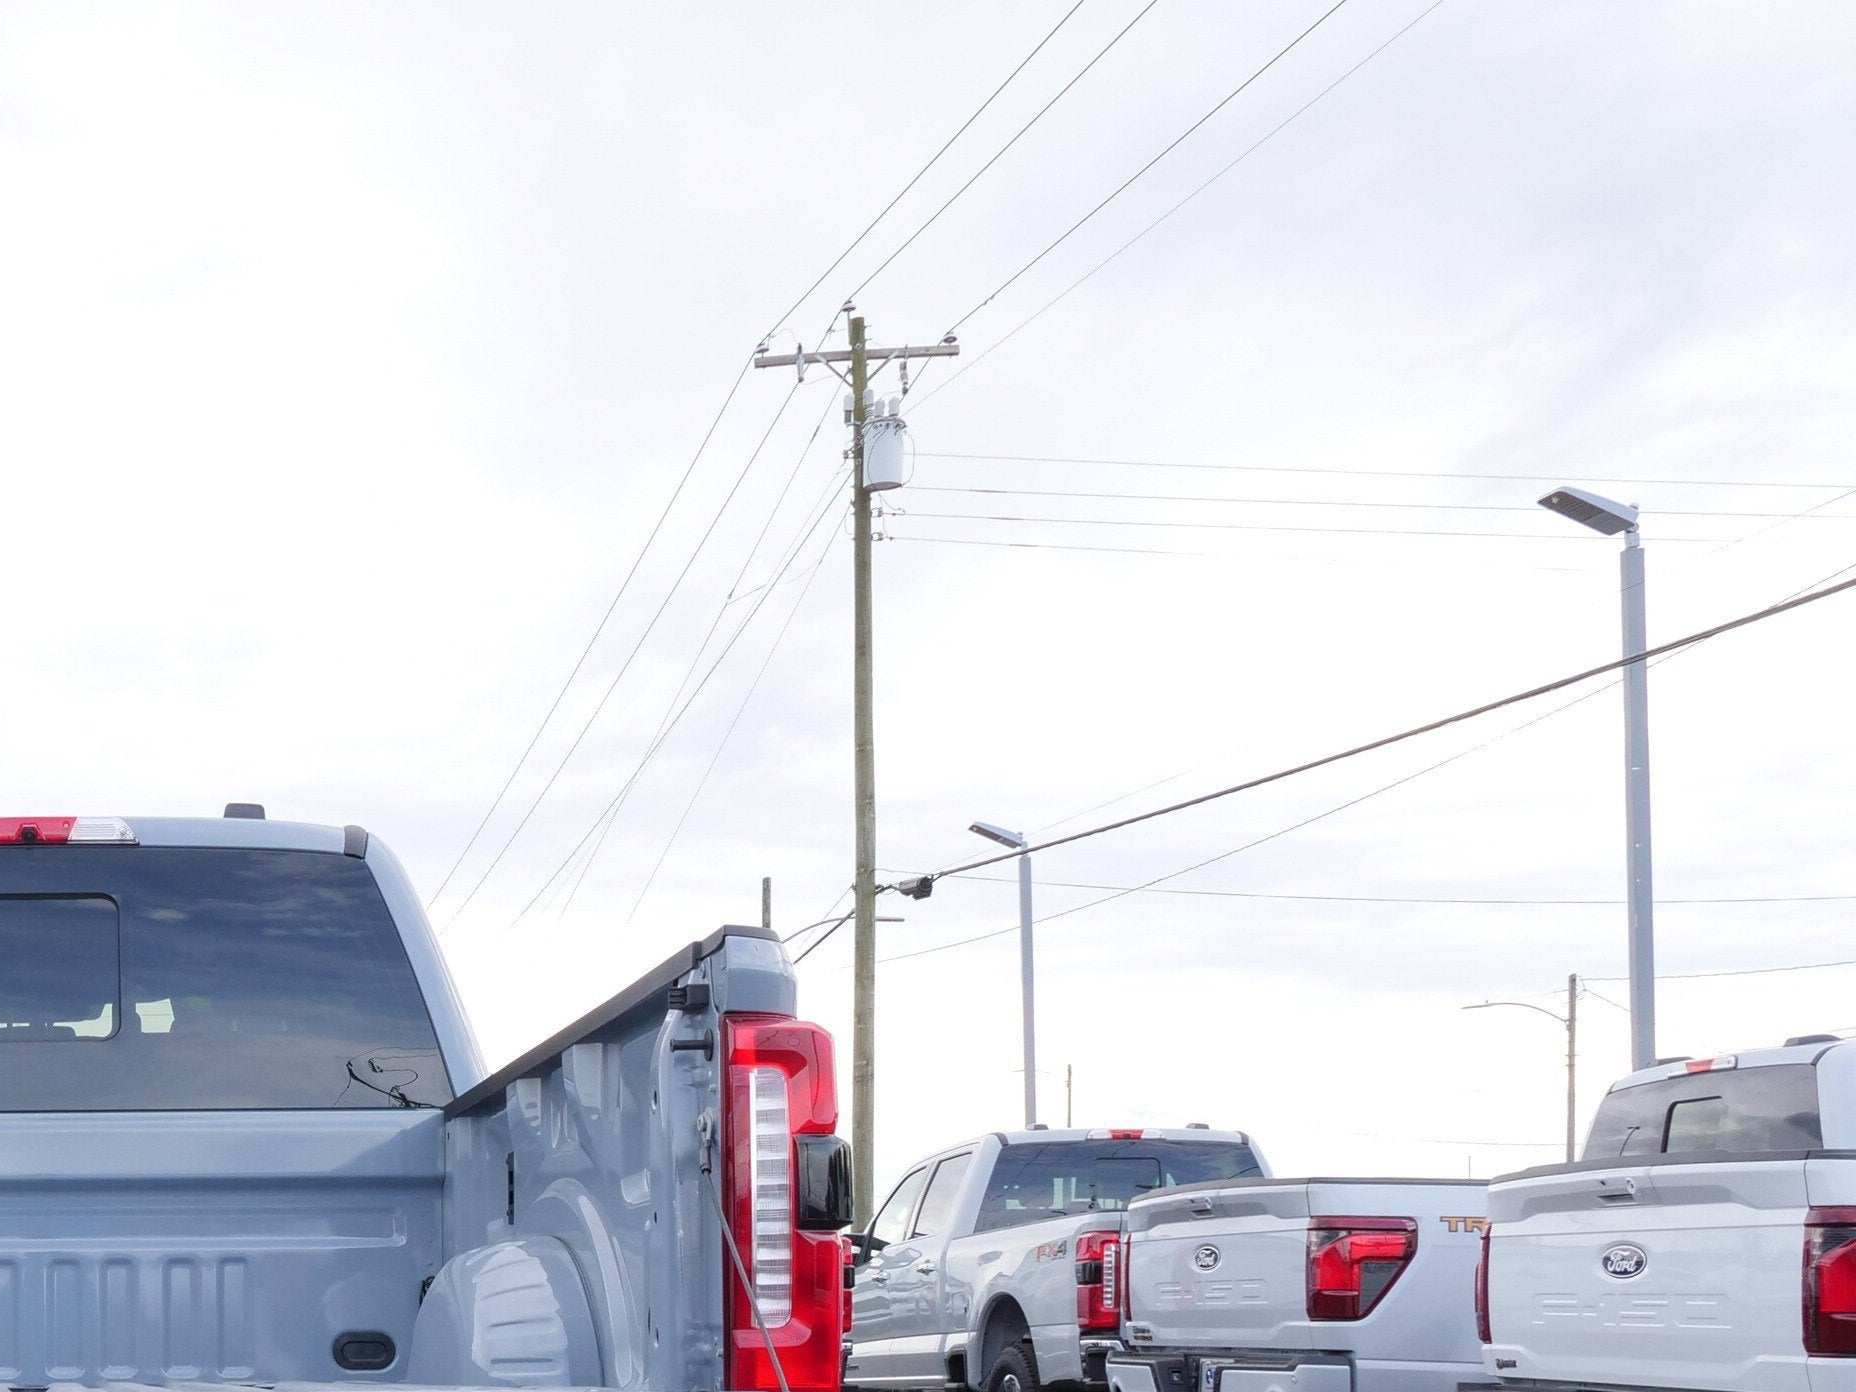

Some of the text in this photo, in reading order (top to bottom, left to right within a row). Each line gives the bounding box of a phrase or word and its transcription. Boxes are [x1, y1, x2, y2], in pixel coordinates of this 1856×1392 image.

[1439, 1215, 1490, 1236] TR
[1036, 1240, 1067, 1262] FX4
[1607, 1250, 1638, 1272] Ford
